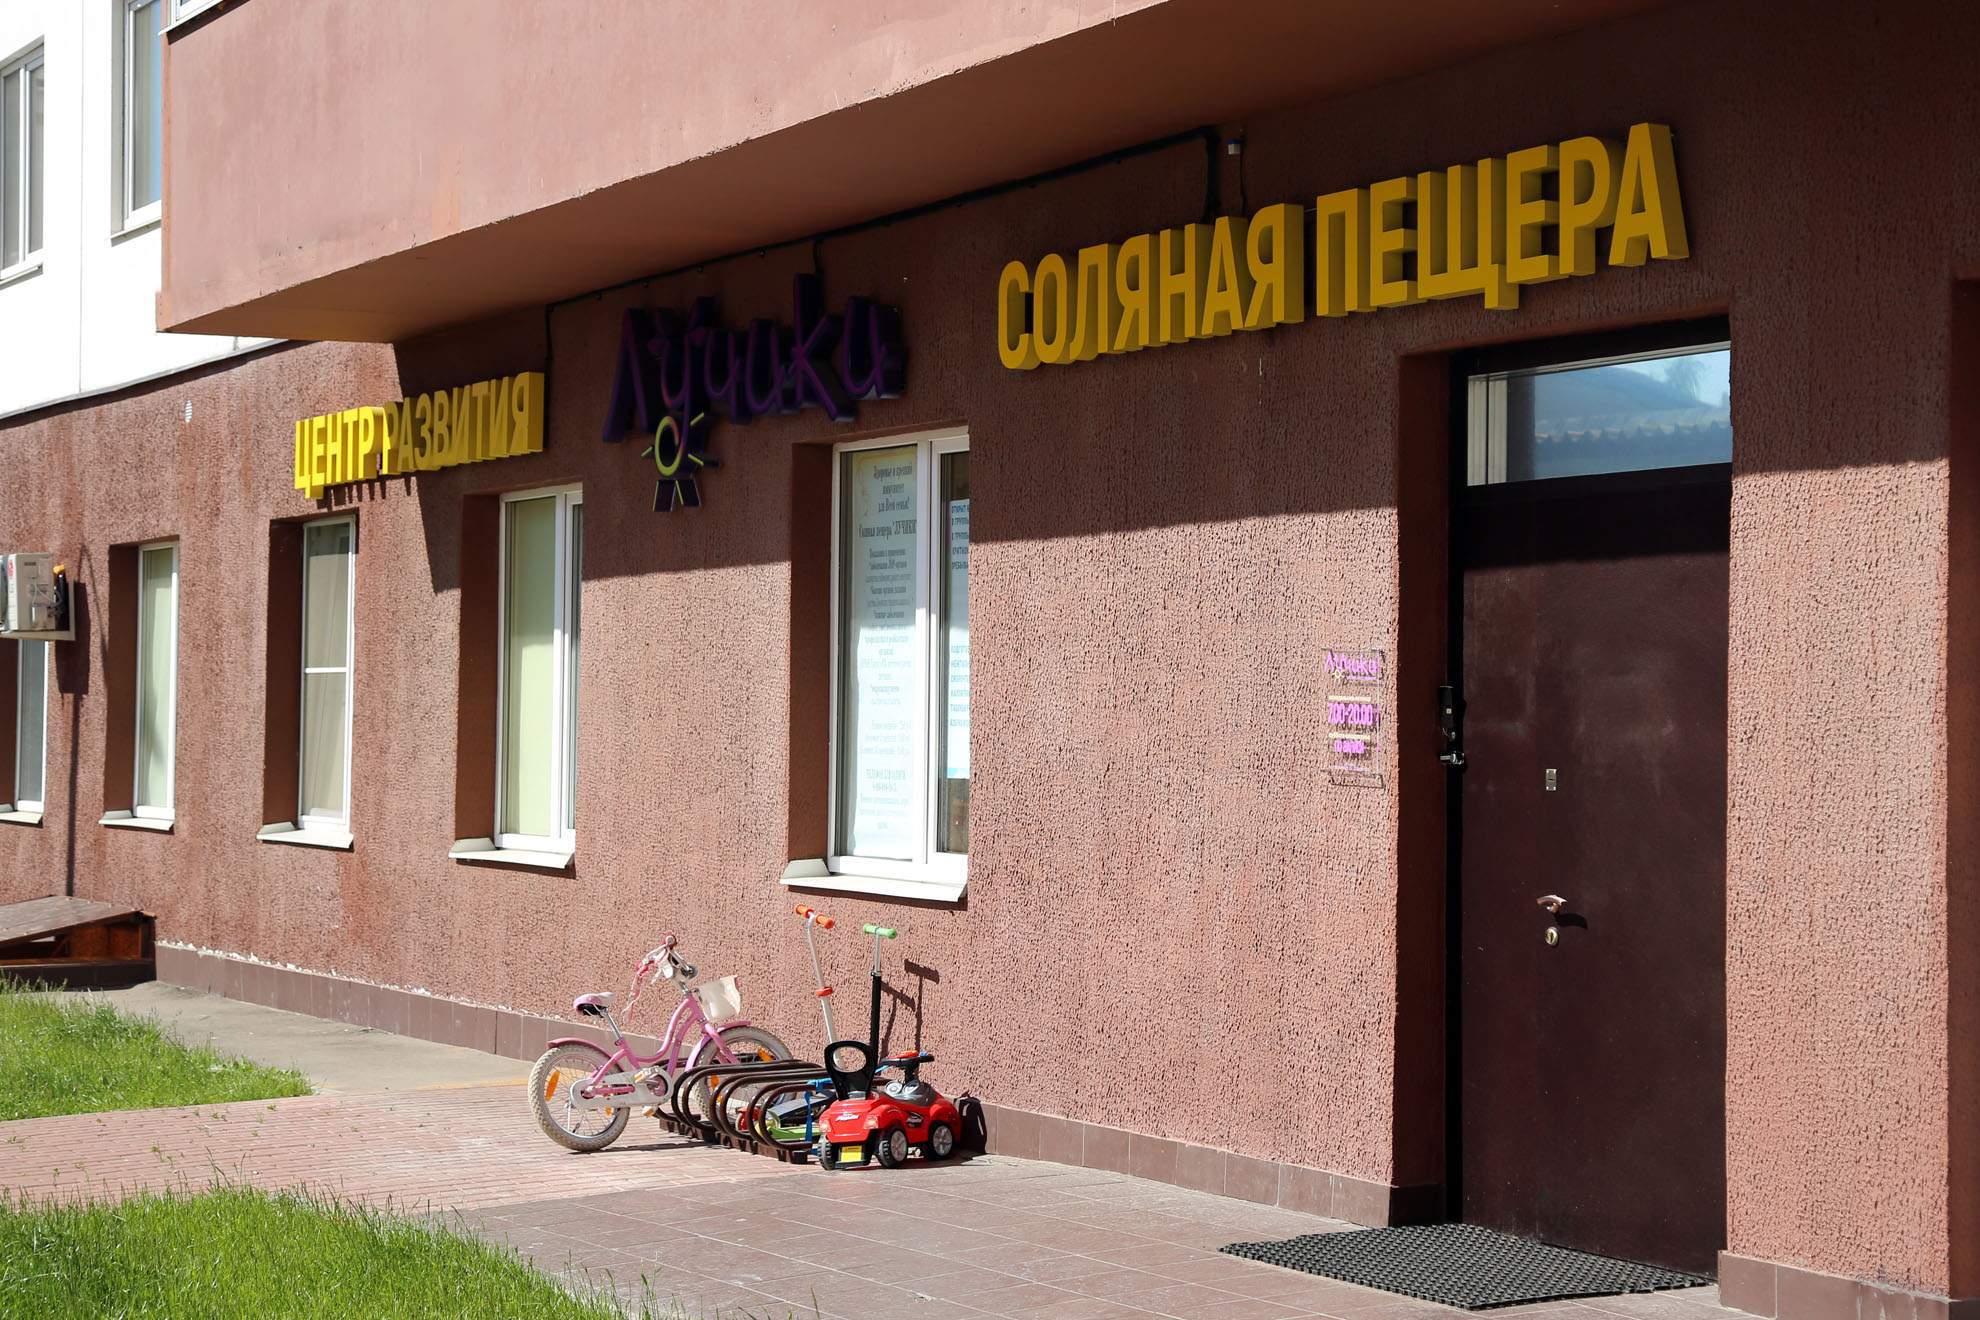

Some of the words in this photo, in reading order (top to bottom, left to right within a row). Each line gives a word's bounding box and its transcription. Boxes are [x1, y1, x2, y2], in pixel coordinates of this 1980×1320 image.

[998, 202, 1304, 370] СОЛЯНАЯ
[1316, 122, 1690, 316] ПЕЩЕРА
[295, 406, 384, 499] ЦЕНТР
[382, 371, 544, 475] РАЗВИТИЯ
[602, 270, 906, 458] Лучики
